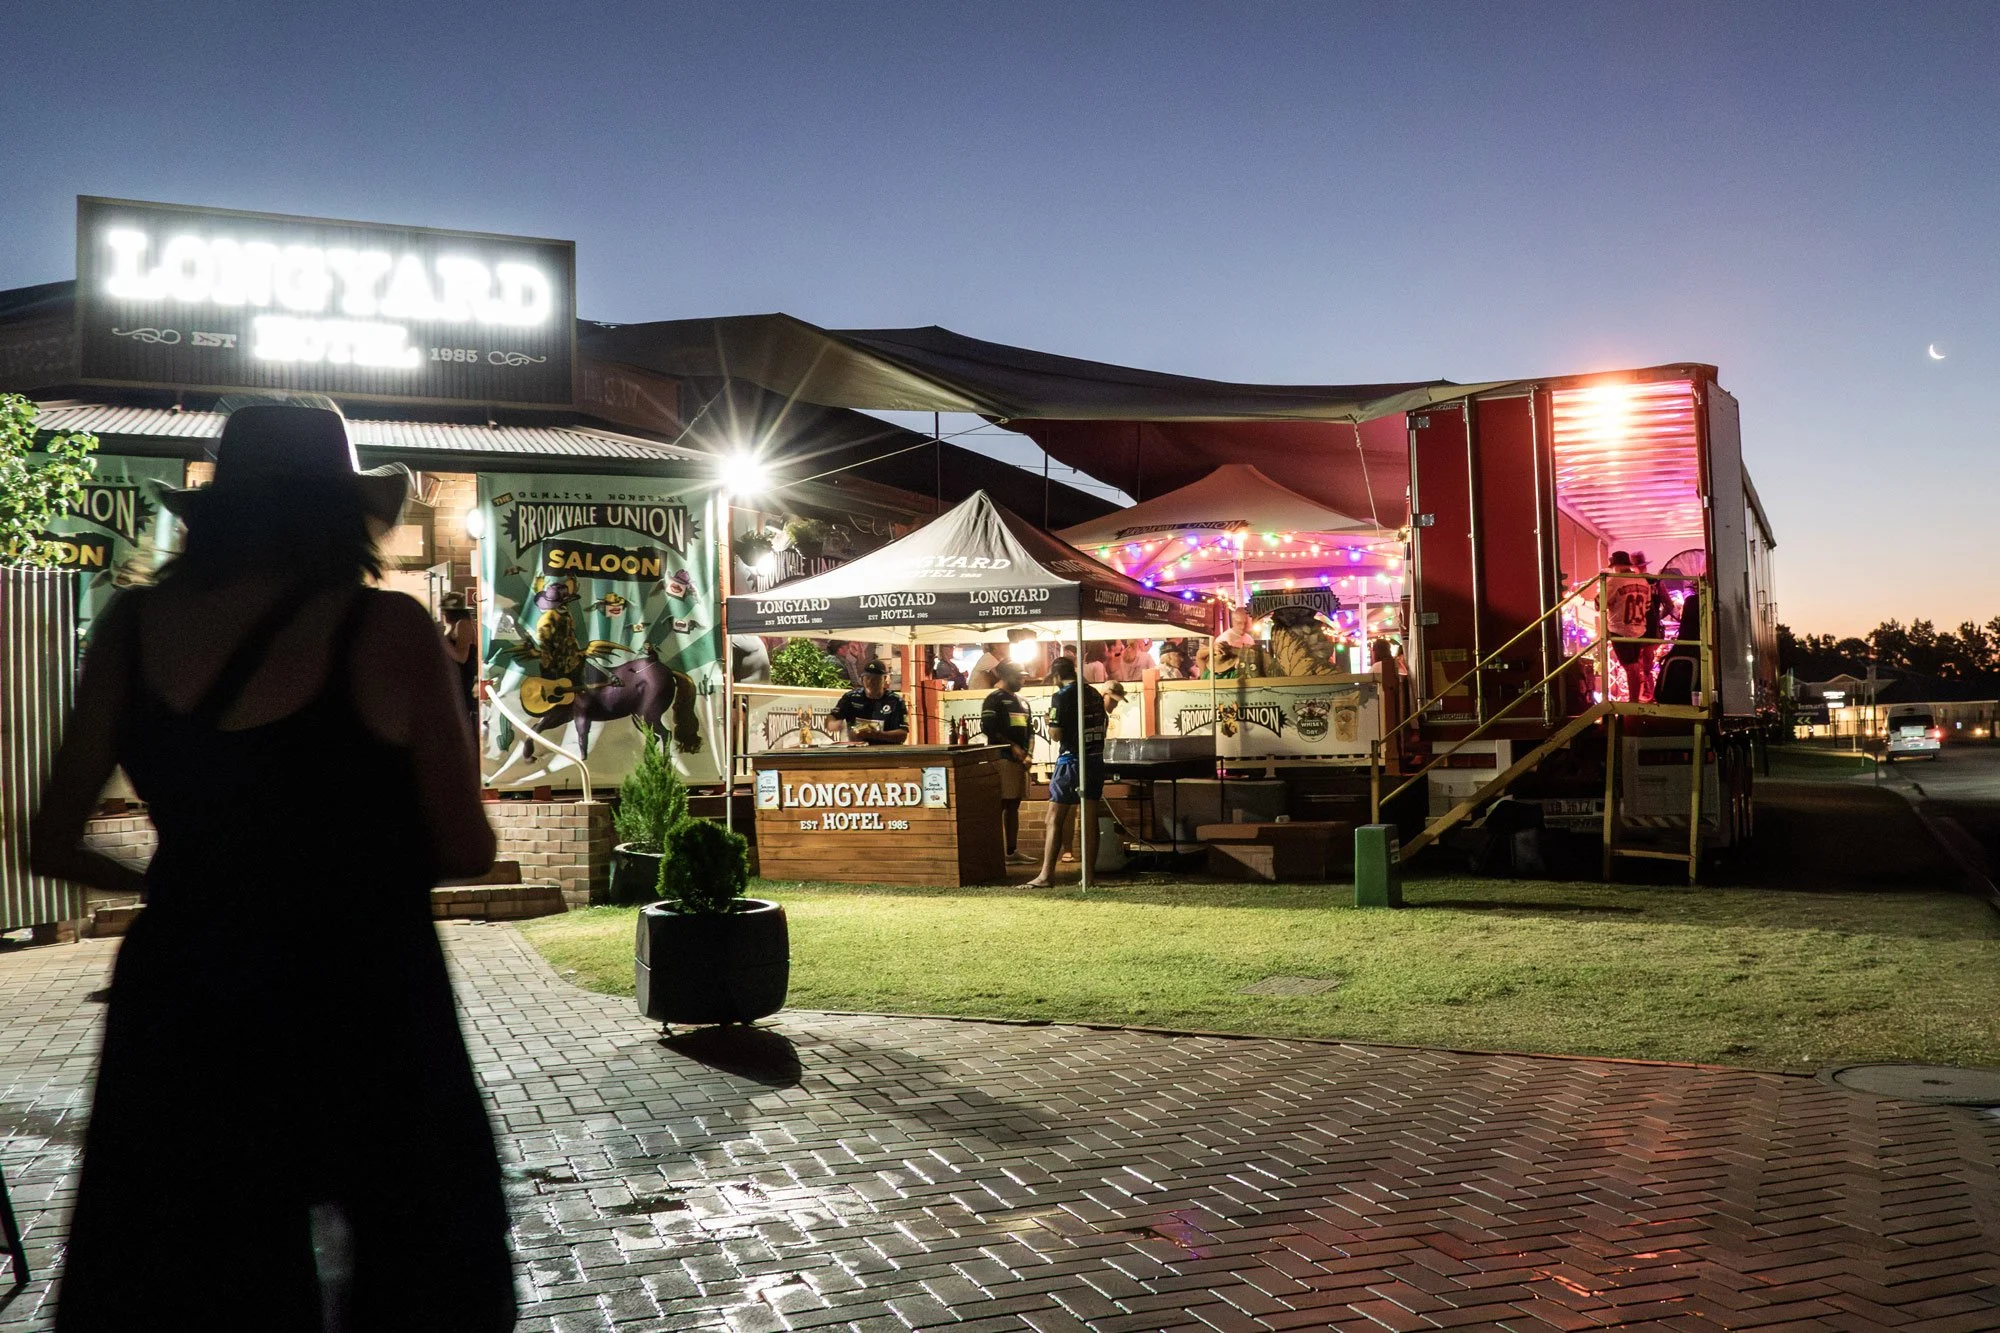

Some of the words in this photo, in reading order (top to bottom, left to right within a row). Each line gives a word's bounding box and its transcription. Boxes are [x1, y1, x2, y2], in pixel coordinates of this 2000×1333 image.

[107, 228, 552, 328] LONGYARD
[190, 331, 237, 348] EST
[430, 347, 478, 363] 1985
[518, 505, 598, 550] BROOKVALE
[606, 506, 685, 553] UNION
[1186, 521, 1242, 532] UNION
[547, 549, 661, 578] SALOON
[859, 592, 937, 609] LONGYARD
[969, 588, 1050, 604] LONGYARD
[1292, 593, 1331, 612] UNION
[757, 597, 831, 615] LONGYARD
[880, 609, 915, 620] HOTEL
[991, 605, 1028, 616] HOTEL
[777, 615, 810, 626] HOTEL
[1238, 707, 1280, 734] UNION
[783, 782, 923, 807] LONGYARD
[800, 821, 818, 830] EST
[821, 812, 884, 830] HOTEL
[887, 820, 909, 830] 1985
